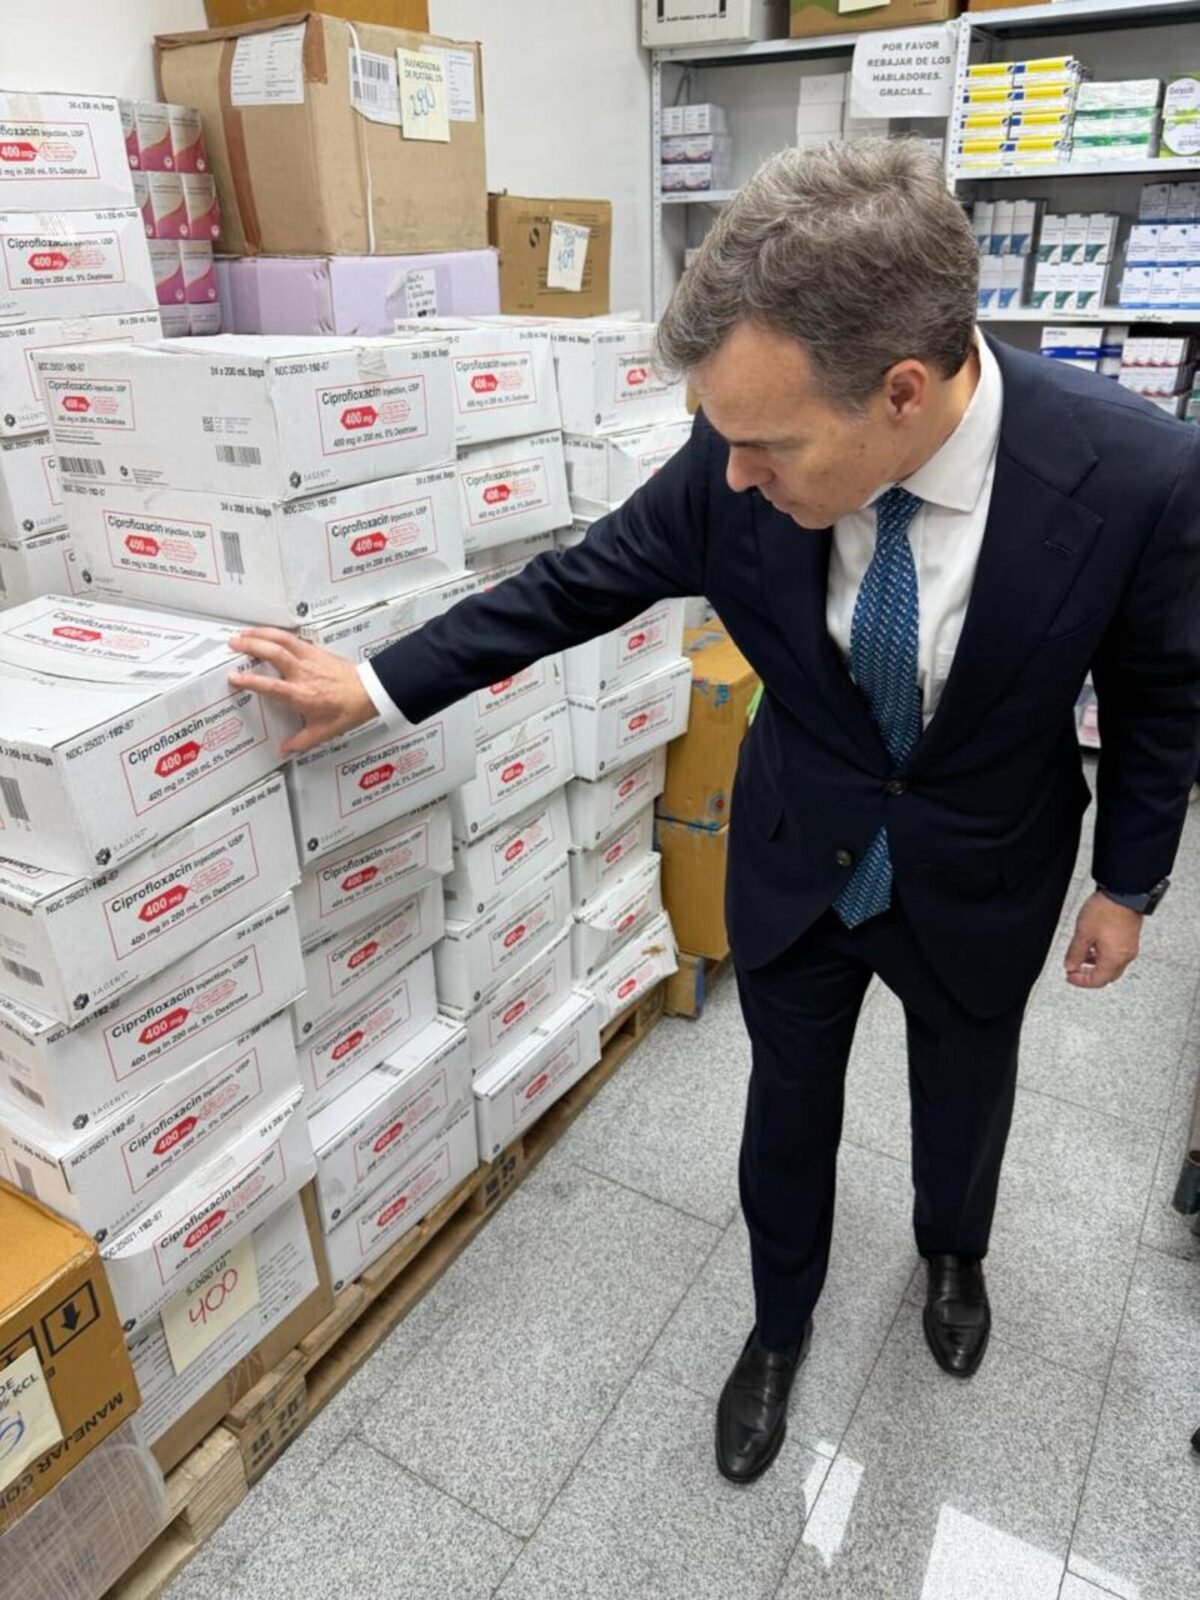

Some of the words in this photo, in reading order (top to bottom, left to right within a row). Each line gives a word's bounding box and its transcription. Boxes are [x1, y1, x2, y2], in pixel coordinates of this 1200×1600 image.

[882, 42, 903, 51] POR
[905, 41, 939, 50] FAVOR
[867, 57, 913, 67] REBAJAR
[915, 57, 929, 66] DE
[931, 56, 952, 65] LOS
[1, 145, 20, 159] 400
[32, 256, 51, 267] 400
[210, 366, 219, 376] 24
[224, 366, 236, 376] 200
[248, 366, 265, 379] Bags
[274, 365, 288, 376] NDC
[321, 385, 380, 406] Ciprofloxacin
[407, 383, 419, 392] USP
[345, 411, 362, 425] 400
[362, 414, 373, 424] mg
[345, 438, 354, 447] mg
[282, 504, 297, 515] NDC
[331, 513, 388, 536] Ciprofloxacin
[415, 506, 426, 515] USP
[107, 515, 163, 532] Ciprofloxacin
[354, 538, 371, 553] 400
[342, 565, 353, 575] 400
[353, 563, 363, 573] mg
[53, 612, 129, 632] Ciprofloxacin
[127, 718, 203, 766] Ciprofloxacin
[237, 692, 252, 707] USP
[66, 745, 84, 760] NDC
[159, 752, 182, 774] 400
[182, 748, 197, 763] mg
[341, 744, 399, 776] Ciprofloxacin
[148, 788, 163, 802] 400
[163, 781, 176, 795] mg
[185, 767, 199, 780] 200
[224, 735, 254, 757] Dextrose
[363, 770, 379, 787] 400
[231, 806, 240, 816] 24
[245, 796, 256, 808] 200
[267, 783, 281, 795] Bags
[111, 861, 192, 913] Ciprofloxacin
[228, 833, 243, 848] USP
[323, 848, 383, 881] Ciprofloxacin
[46, 898, 65, 915] NDC
[130, 932, 145, 946] 400
[146, 924, 160, 938] mg
[170, 908, 185, 922] 200
[212, 873, 245, 897] Dextrose
[143, 895, 168, 919] 400
[168, 891, 183, 906] mg
[236, 931, 246, 940] 24
[252, 922, 264, 932] 200
[274, 904, 291, 917] Bags
[111, 985, 195, 1039] Ciprofloxacin
[232, 956, 247, 970] USP
[46, 1029, 65, 1045] NDC
[130, 1053, 146, 1067] 400
[147, 1045, 161, 1059] mg
[172, 1028, 187, 1042] 200
[215, 991, 248, 1016] Dextrose
[144, 1019, 168, 1042] 400
[169, 1014, 184, 1029] mg
[128, 1093, 202, 1153] Ciprofloxacin
[235, 1058, 248, 1073] USP
[158, 1128, 179, 1152] 400
[179, 1121, 193, 1137] mg
[260, 1130, 268, 1138] 24
[272, 1118, 284, 1130] 200
[71, 1151, 87, 1168] NDC
[160, 1154, 172, 1168] mg
[160, 1188, 229, 1250] Ciprofloxacin
[188, 1222, 208, 1246] 400
[189, 1268, 238, 1325] 400
[12, 1374, 39, 1397] KCL
[37, 1391, 124, 1474] MANEJAR
